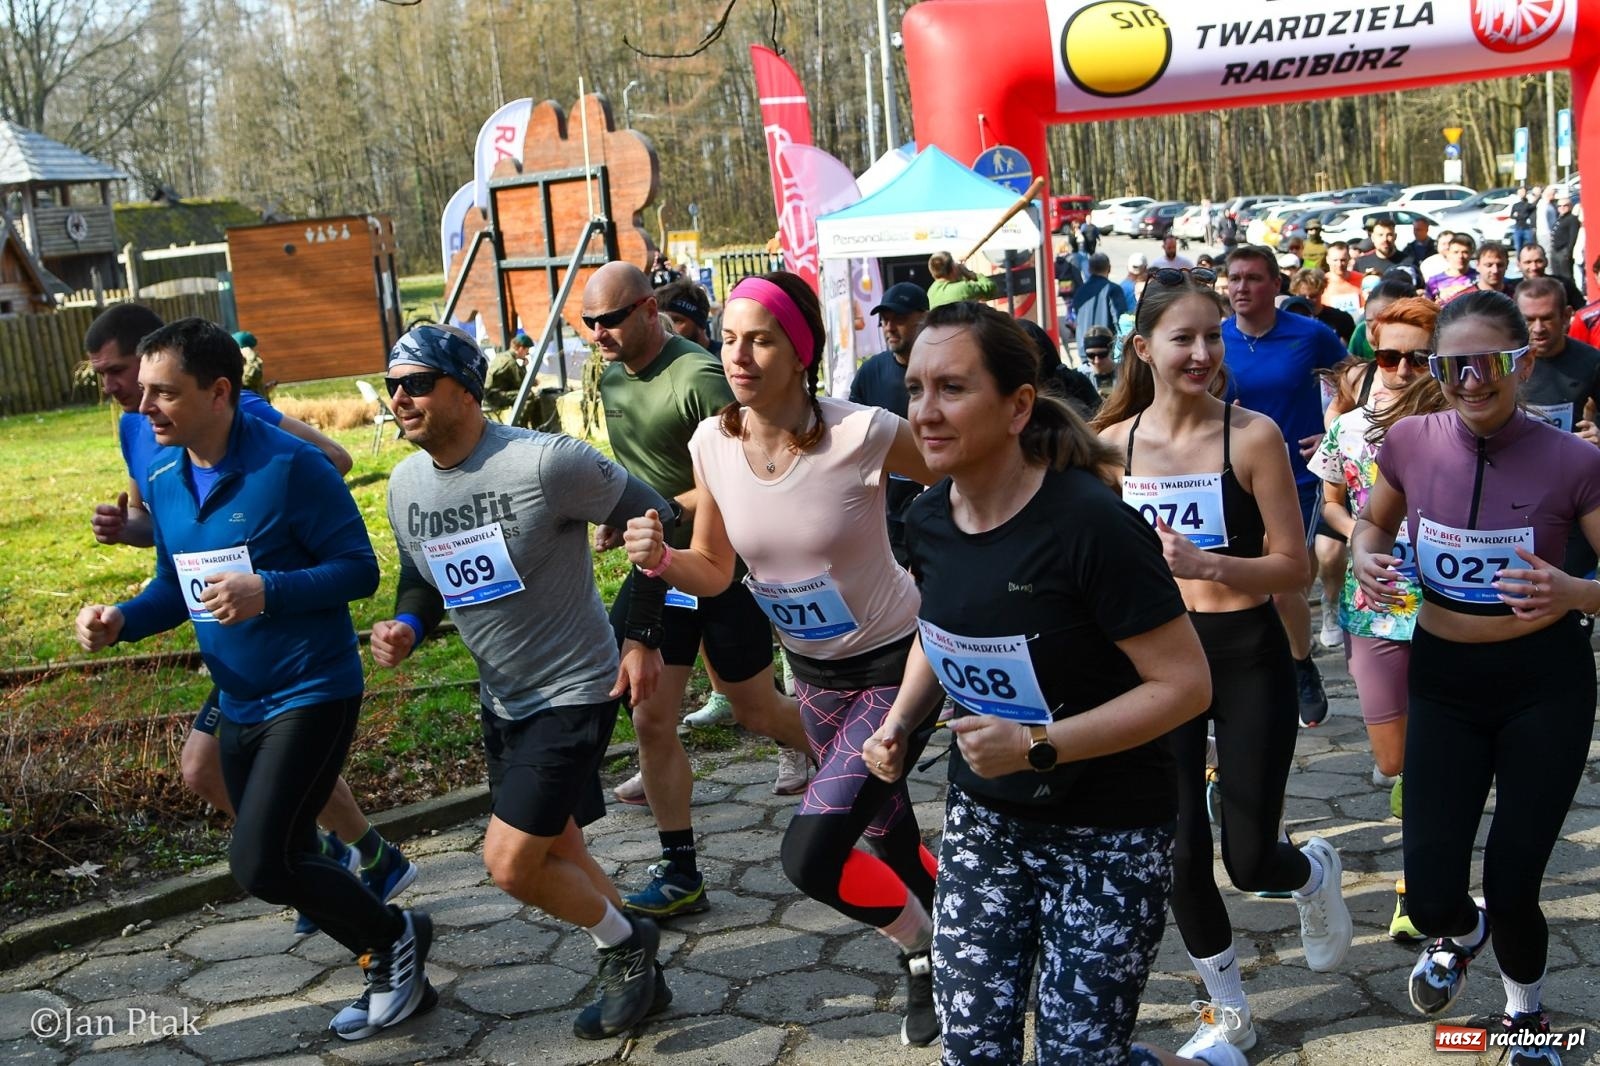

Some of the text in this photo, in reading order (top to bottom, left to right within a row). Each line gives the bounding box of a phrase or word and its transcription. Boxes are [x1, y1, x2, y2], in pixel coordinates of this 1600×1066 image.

[1196, 1, 1434, 49] TWARDZIELA
[1220, 43, 1411, 86] RACIBÓRZ
[1160, 479, 1212, 490] TWARDZIELA
[408, 491, 517, 538] CrossFit
[1139, 502, 1204, 529] 074
[451, 531, 496, 548] TWARDZIELA
[1424, 526, 1525, 544] XIV BIEG TWARDZIELA
[445, 555, 495, 588] 069
[1435, 552, 1510, 584] 027
[777, 581, 827, 594] TWARDZIELA
[772, 601, 827, 625] 071
[954, 640, 1016, 653] TWARDZIELA
[941, 657, 1017, 699] 068
